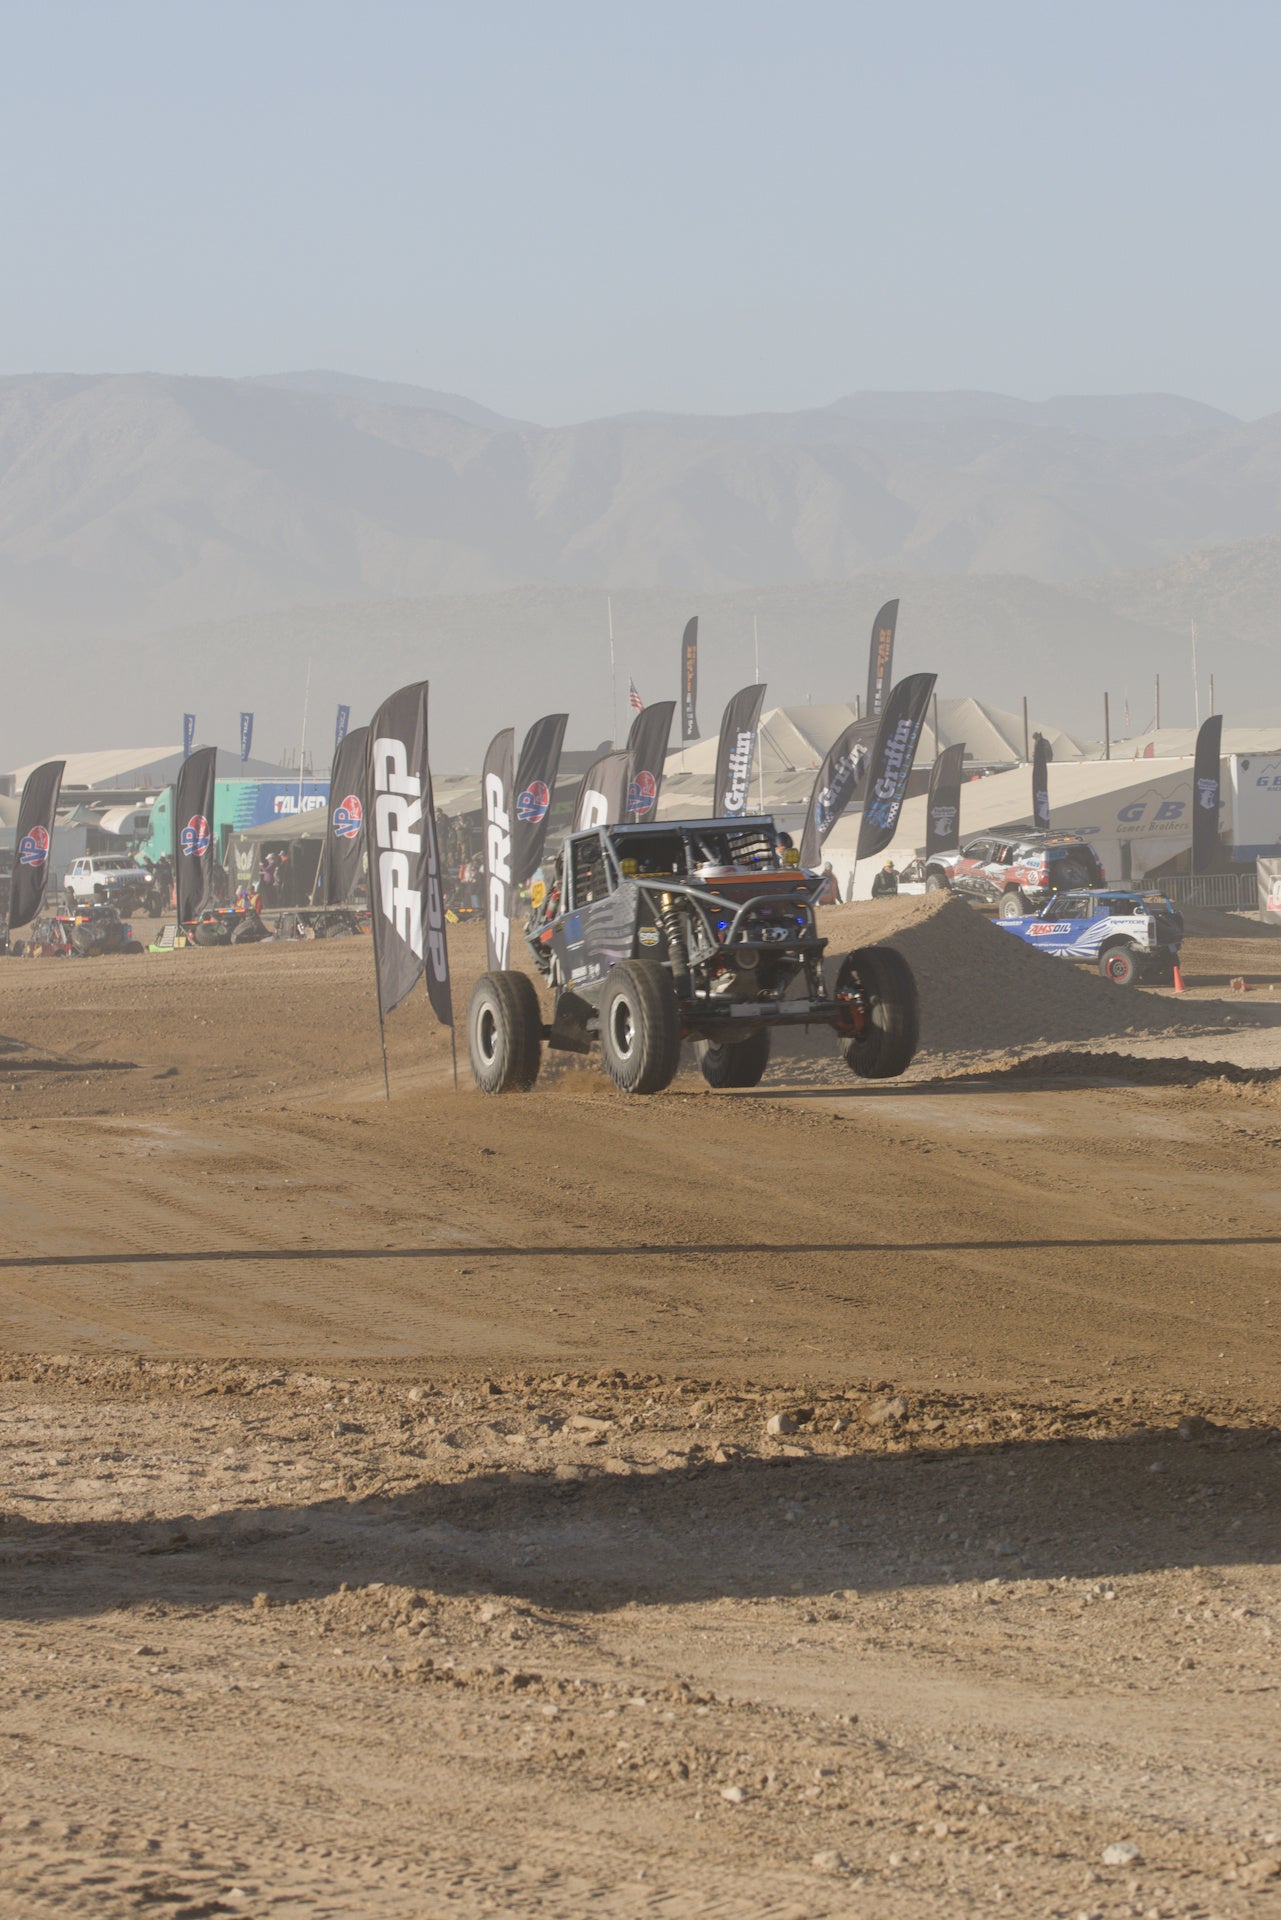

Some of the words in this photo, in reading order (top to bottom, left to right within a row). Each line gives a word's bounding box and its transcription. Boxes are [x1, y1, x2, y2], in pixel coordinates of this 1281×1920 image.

[724, 731, 752, 811] Griffin
[875, 719, 912, 799] Griffin
[517, 791, 547, 821] VP
[627, 783, 655, 812] VP
[333, 807, 361, 837] VP
[19, 836, 47, 866] VP
[181, 827, 209, 856] VP
[373, 738, 423, 960] PRP
[486, 772, 511, 971] PRP
[1029, 924, 1071, 935] AMSOIL
